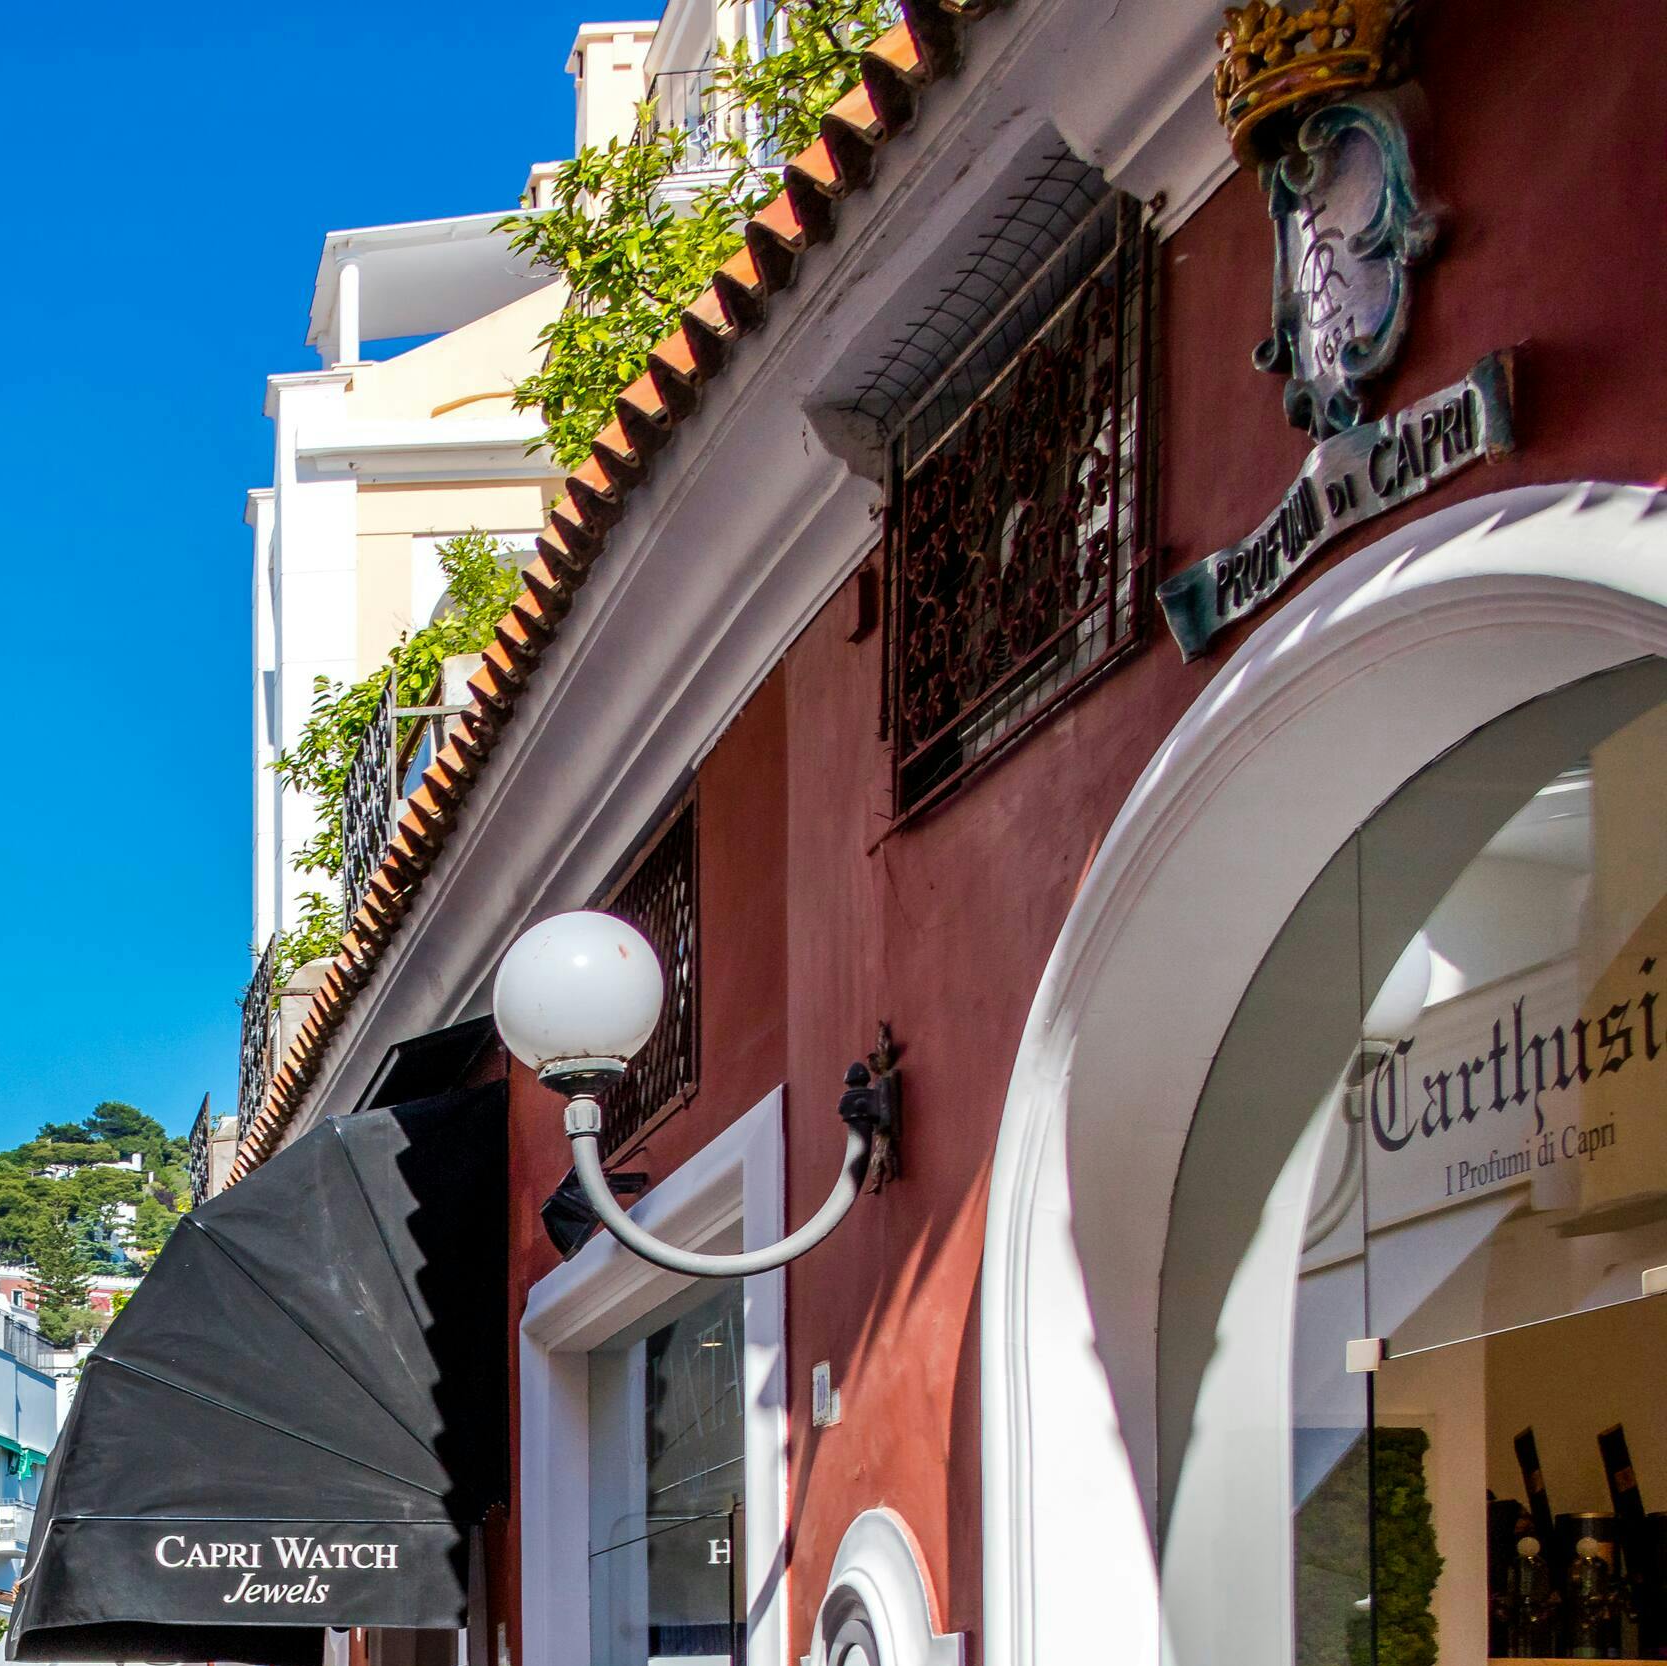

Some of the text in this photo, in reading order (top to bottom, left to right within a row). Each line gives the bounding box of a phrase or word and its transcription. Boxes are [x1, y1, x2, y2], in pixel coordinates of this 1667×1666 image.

[1216, 388, 1480, 617] PROFUMI DI CAPRI
[1458, 1139, 1531, 1193] Profumi
[1537, 1130, 1556, 1167] di
[1561, 1111, 1616, 1162] Capri
[155, 1535, 399, 1569] CAPRI WATCH
[223, 1572, 330, 1604] Jewels
